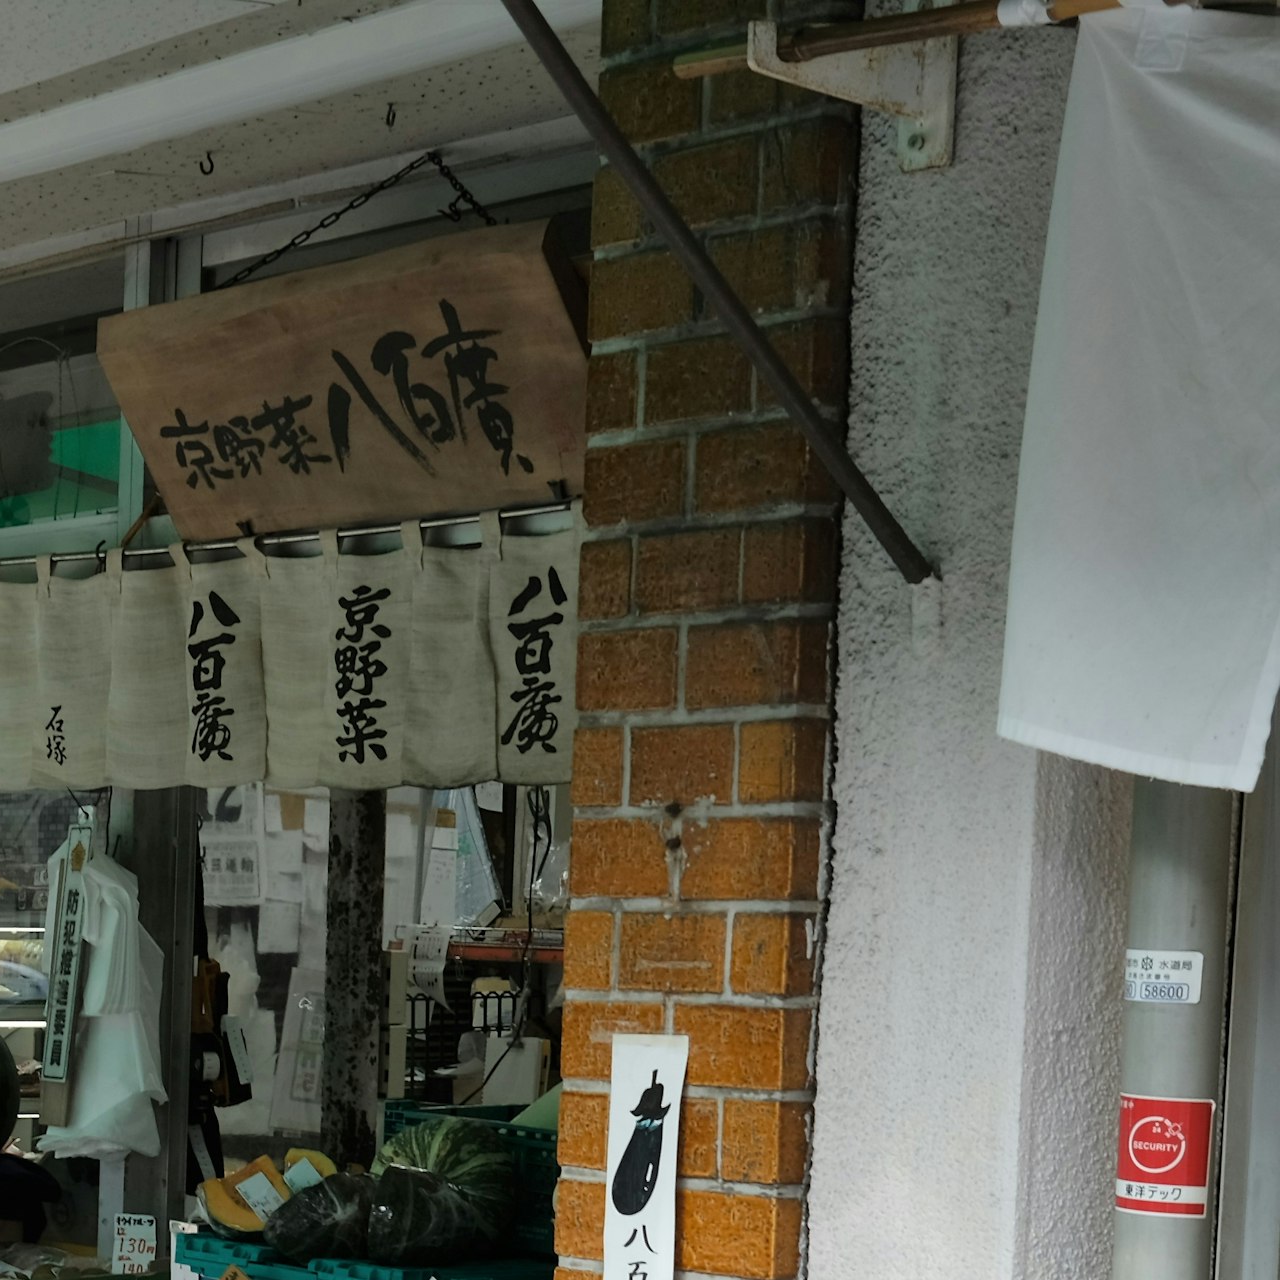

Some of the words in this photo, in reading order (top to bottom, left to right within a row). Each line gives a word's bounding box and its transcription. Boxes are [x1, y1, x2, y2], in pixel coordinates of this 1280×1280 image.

[160, 395, 332, 488] 京野菜
[335, 584, 391, 764] 京野菜
[1160, 961, 1193, 971] 水道局
[1145, 984, 1184, 998] 58600
[1133, 1140, 1179, 1153] SECURITY
[1125, 1184, 1181, 1201] 東洋テック
[120, 1237, 155, 1254] 130円
